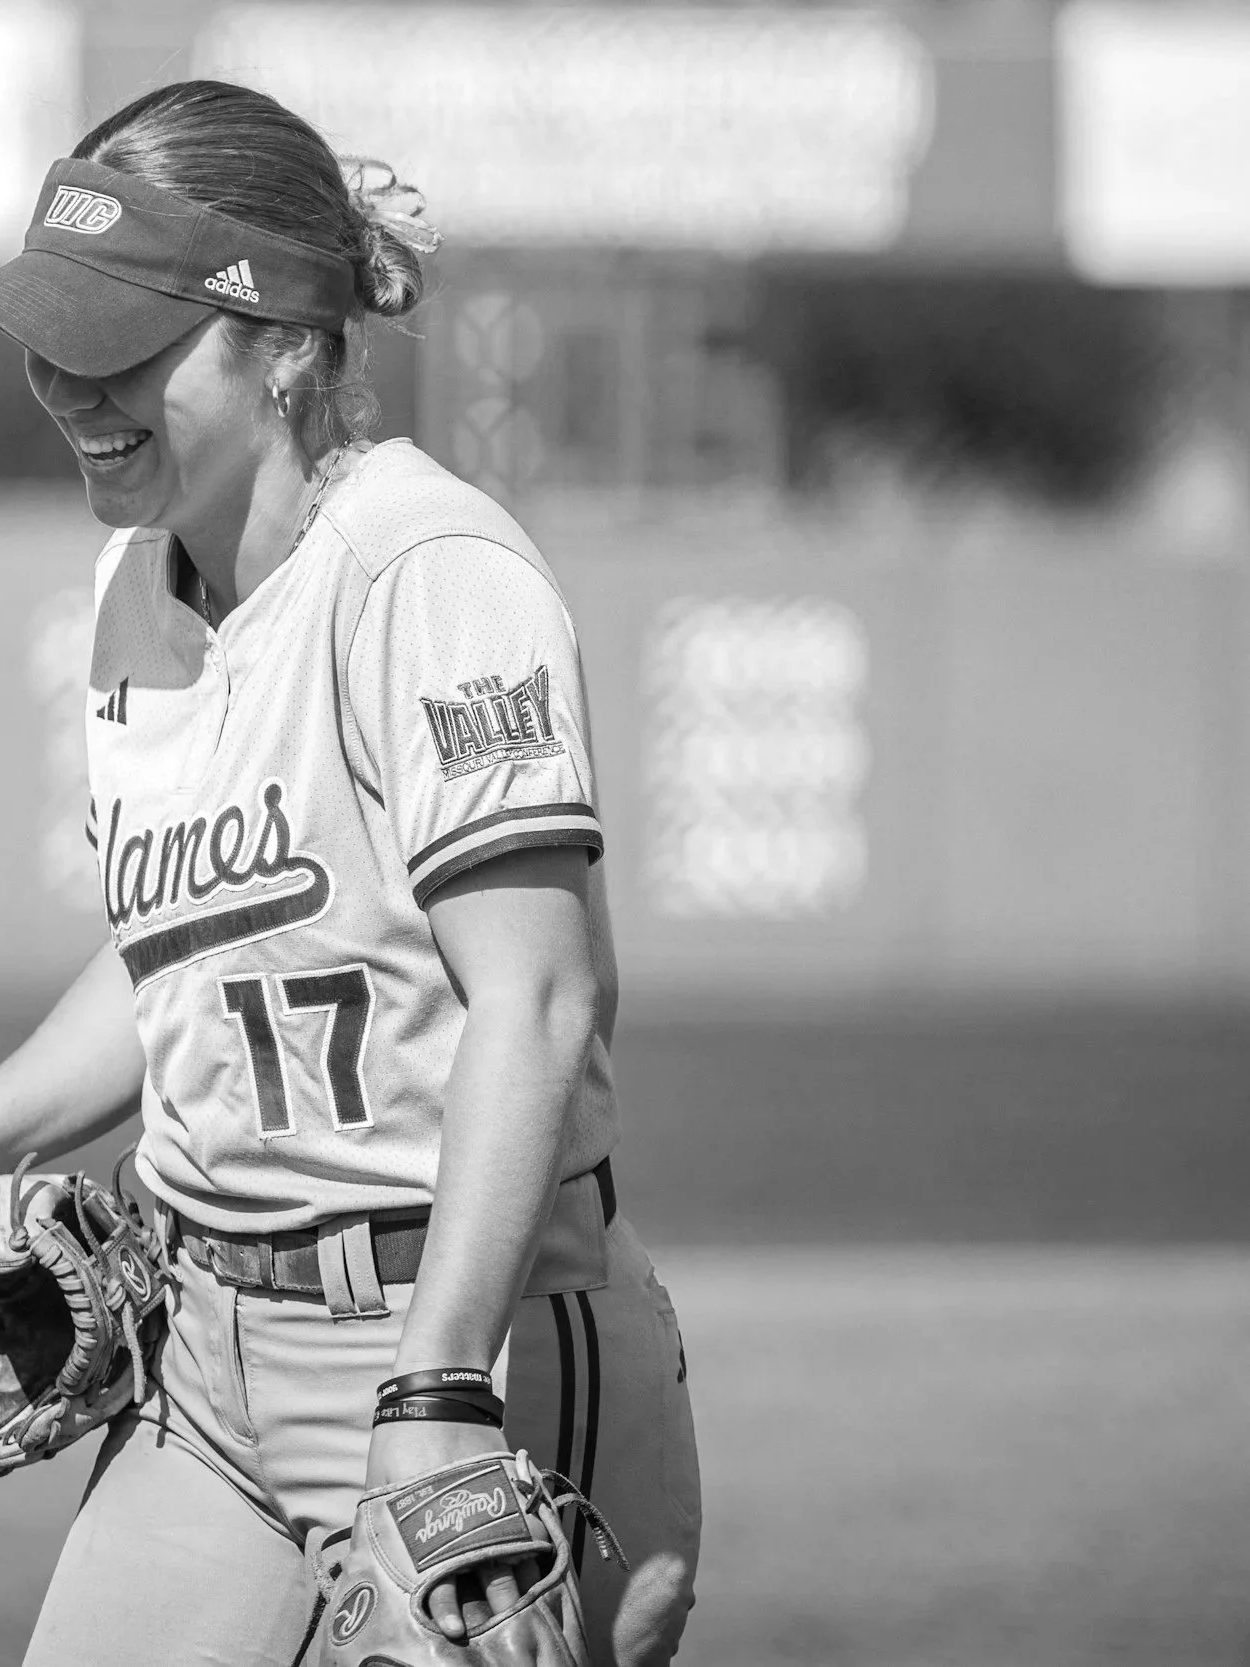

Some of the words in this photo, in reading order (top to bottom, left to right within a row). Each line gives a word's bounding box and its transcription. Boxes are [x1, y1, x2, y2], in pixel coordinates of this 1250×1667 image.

[45, 186, 121, 233] UIC
[204, 277, 260, 303] adidas
[457, 675, 507, 700] THE
[419, 664, 555, 766] VALLEY
[103, 776, 320, 940] lames
[217, 962, 377, 1140] 17
[441, 1372, 483, 1382] matters
[402, 1402, 427, 1418] Play
[415, 1486, 506, 1543] Rawlings
